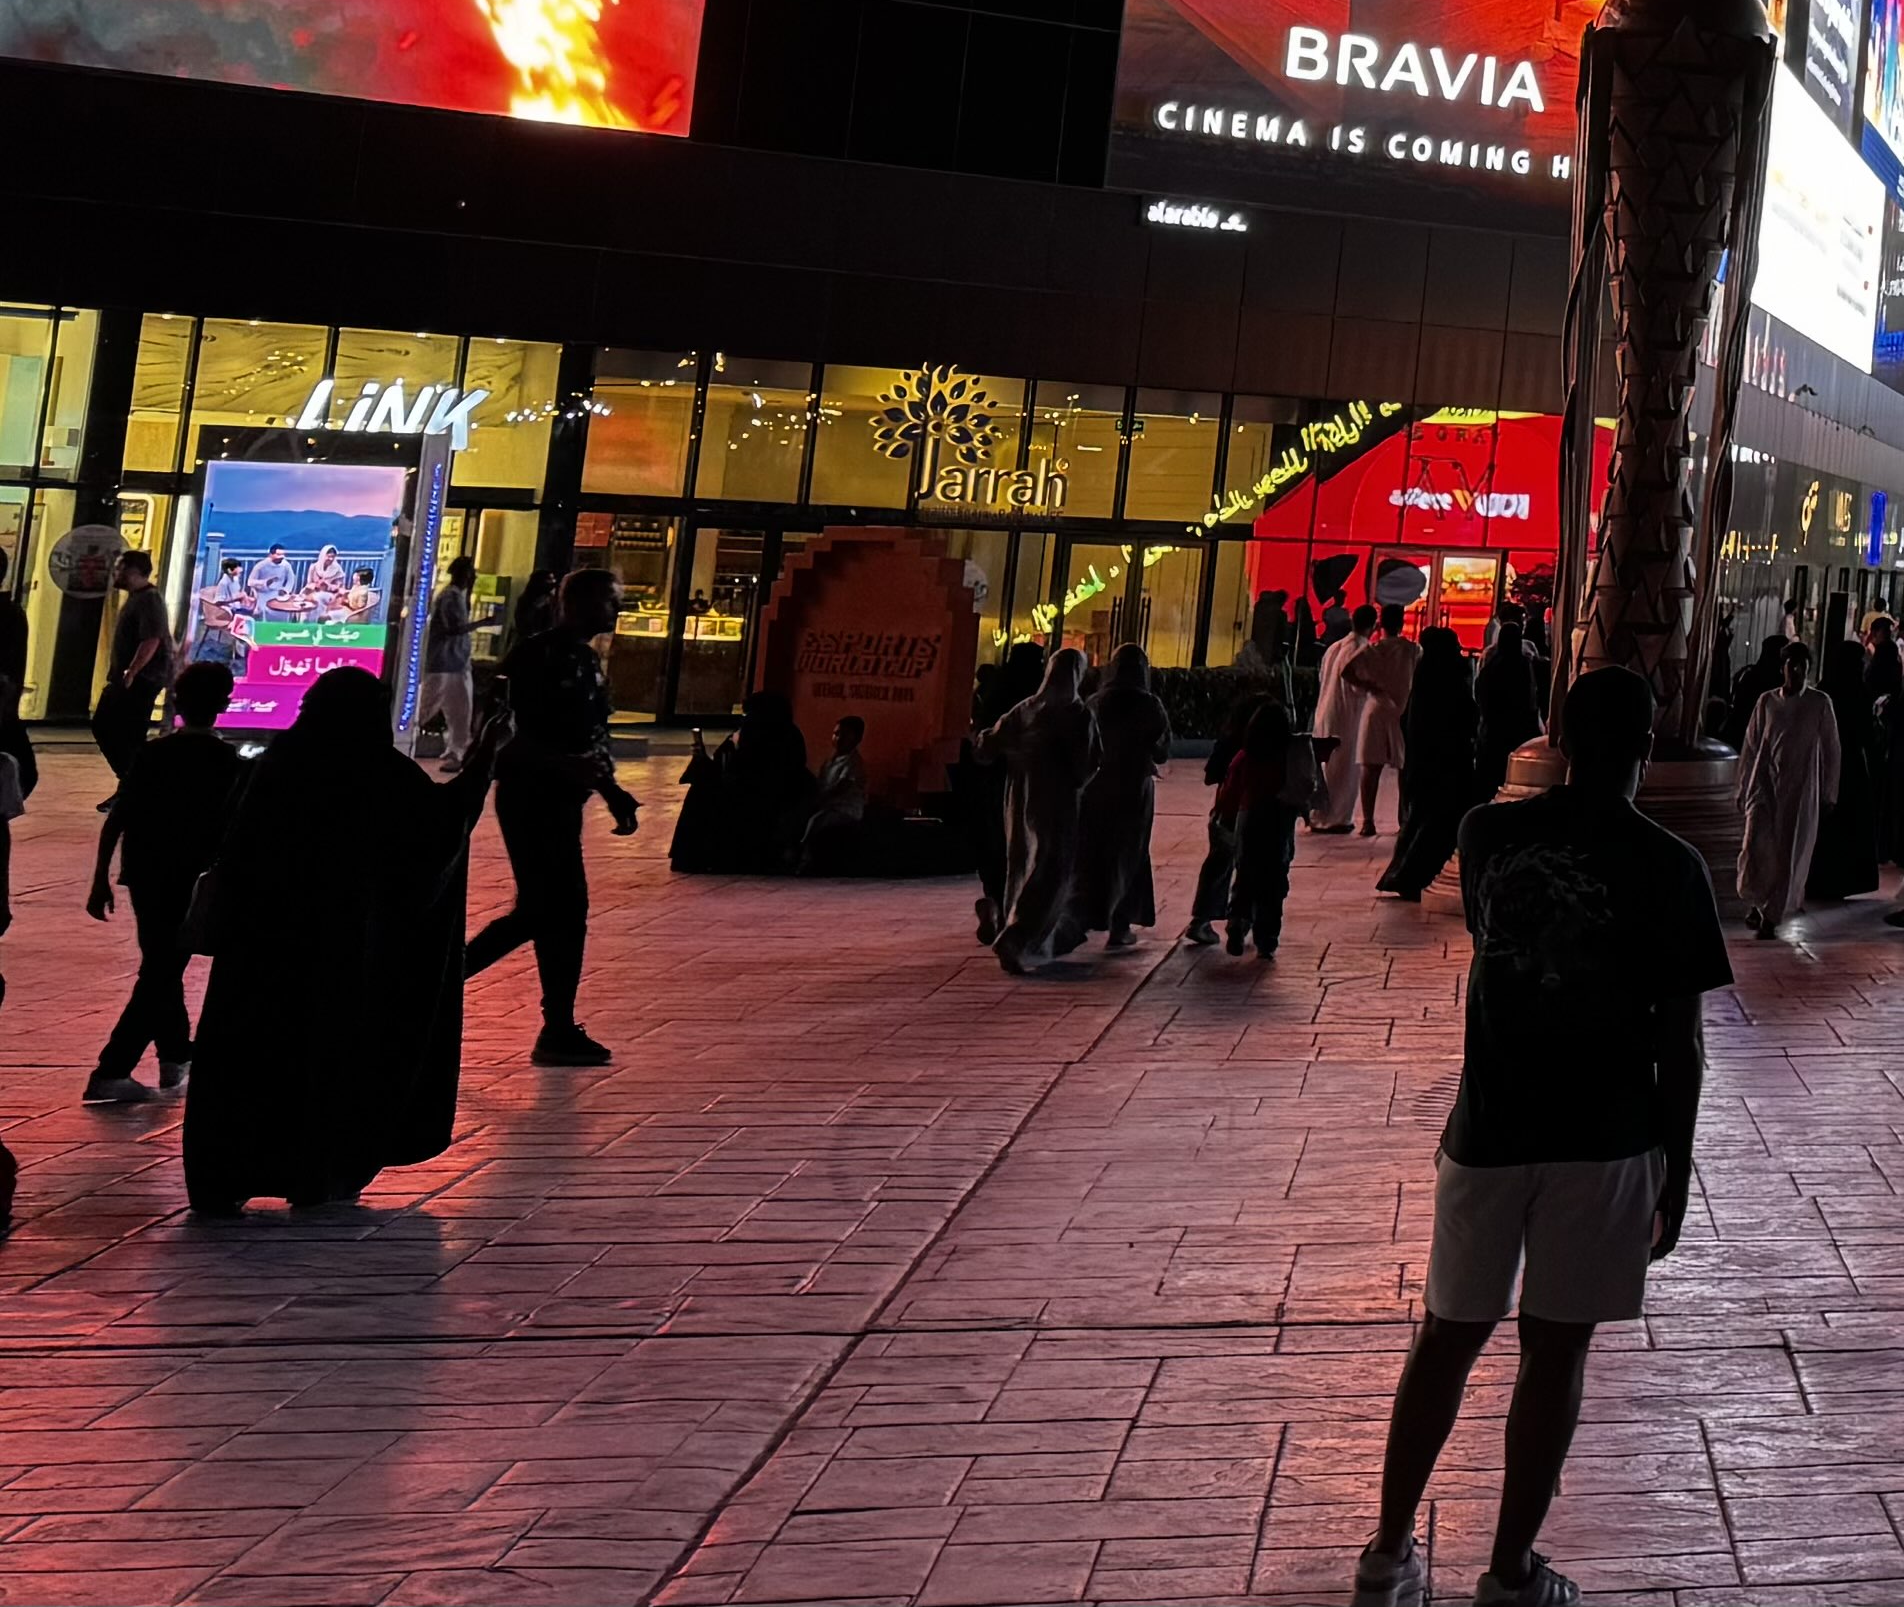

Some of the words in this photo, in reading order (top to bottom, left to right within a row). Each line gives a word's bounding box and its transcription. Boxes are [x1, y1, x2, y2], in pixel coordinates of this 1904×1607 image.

[1284, 26, 1546, 112] BRAVIA
[1158, 102, 1308, 149] CINEMA
[1331, 126, 1366, 154] IS
[1388, 133, 1530, 176] COMING
[914, 435, 1069, 507] Jarrah
